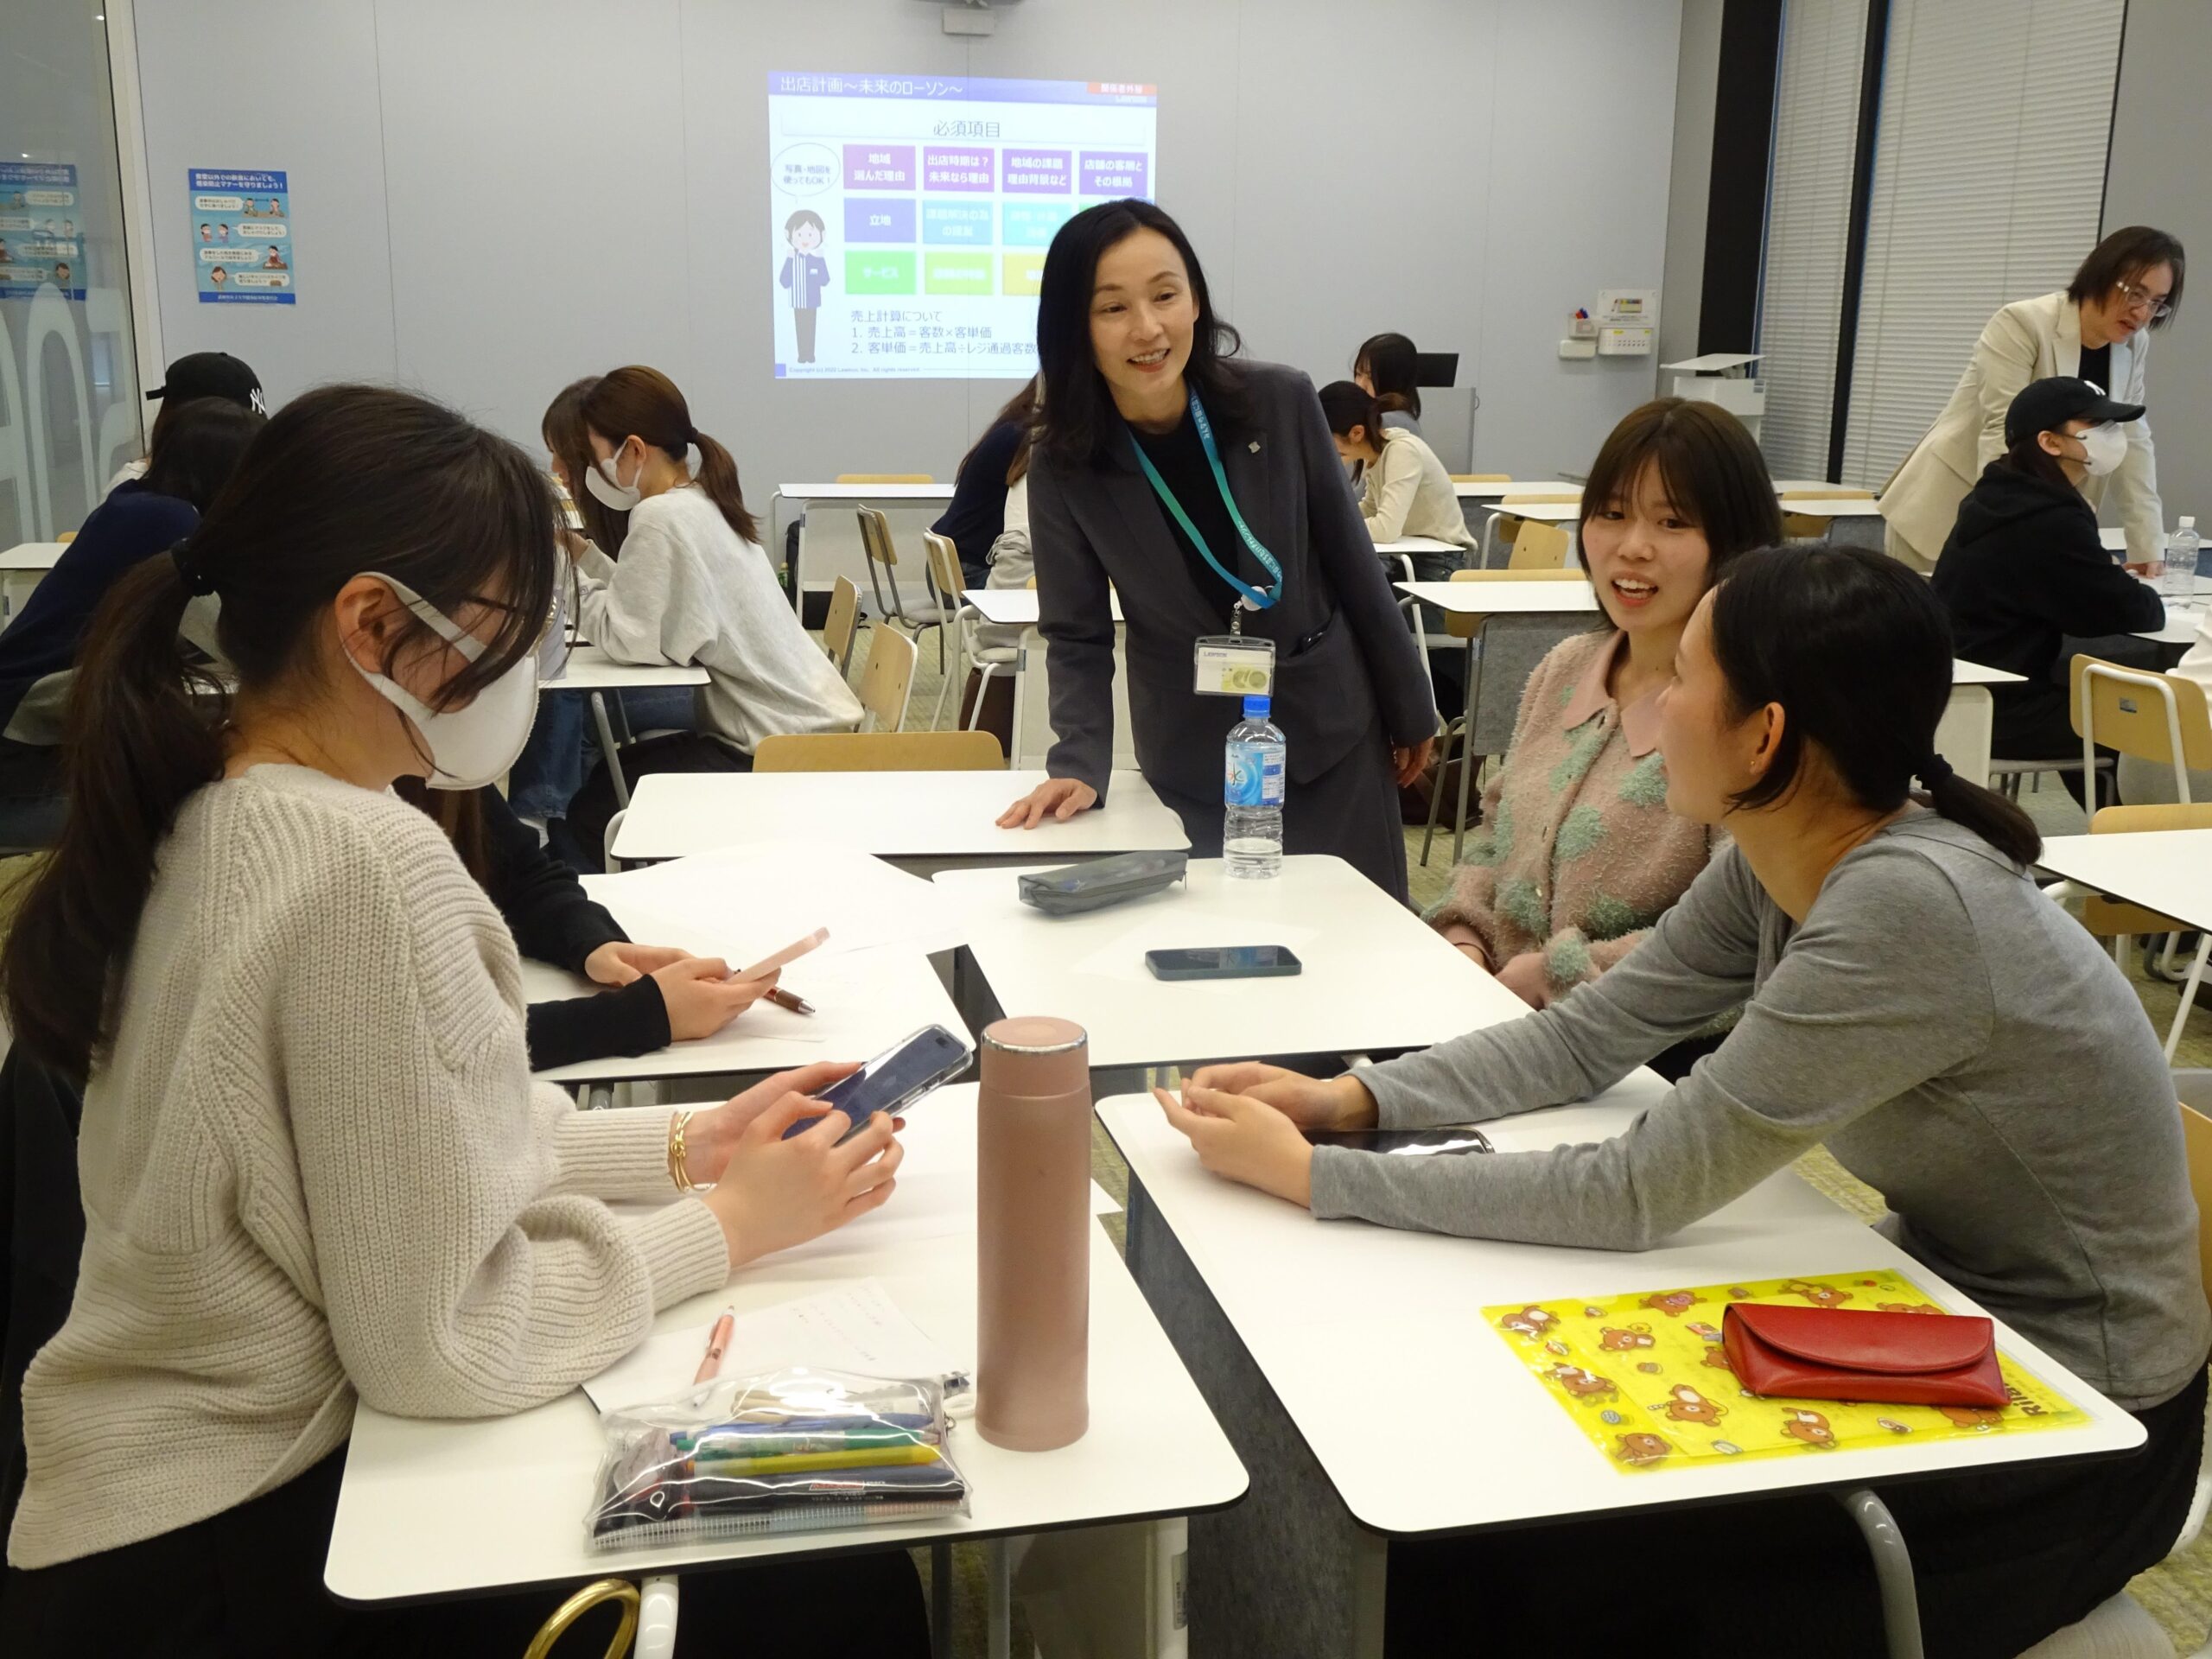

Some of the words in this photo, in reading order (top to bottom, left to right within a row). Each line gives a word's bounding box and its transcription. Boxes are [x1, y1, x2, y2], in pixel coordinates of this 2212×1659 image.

[933, 119, 1001, 138] 必須項目
[868, 153, 892, 165] 地域
[927, 155, 988, 167] 出店時期は？
[1011, 157, 1063, 169] 地域の課題
[854, 169, 906, 182] 選んだ理由
[929, 171, 989, 184] 未来なら理由
[1007, 174, 1066, 186] 理由背景など
[869, 214, 892, 226] 立地
[863, 267, 899, 279] サービス
[851, 310, 943, 322] 売上計算について
